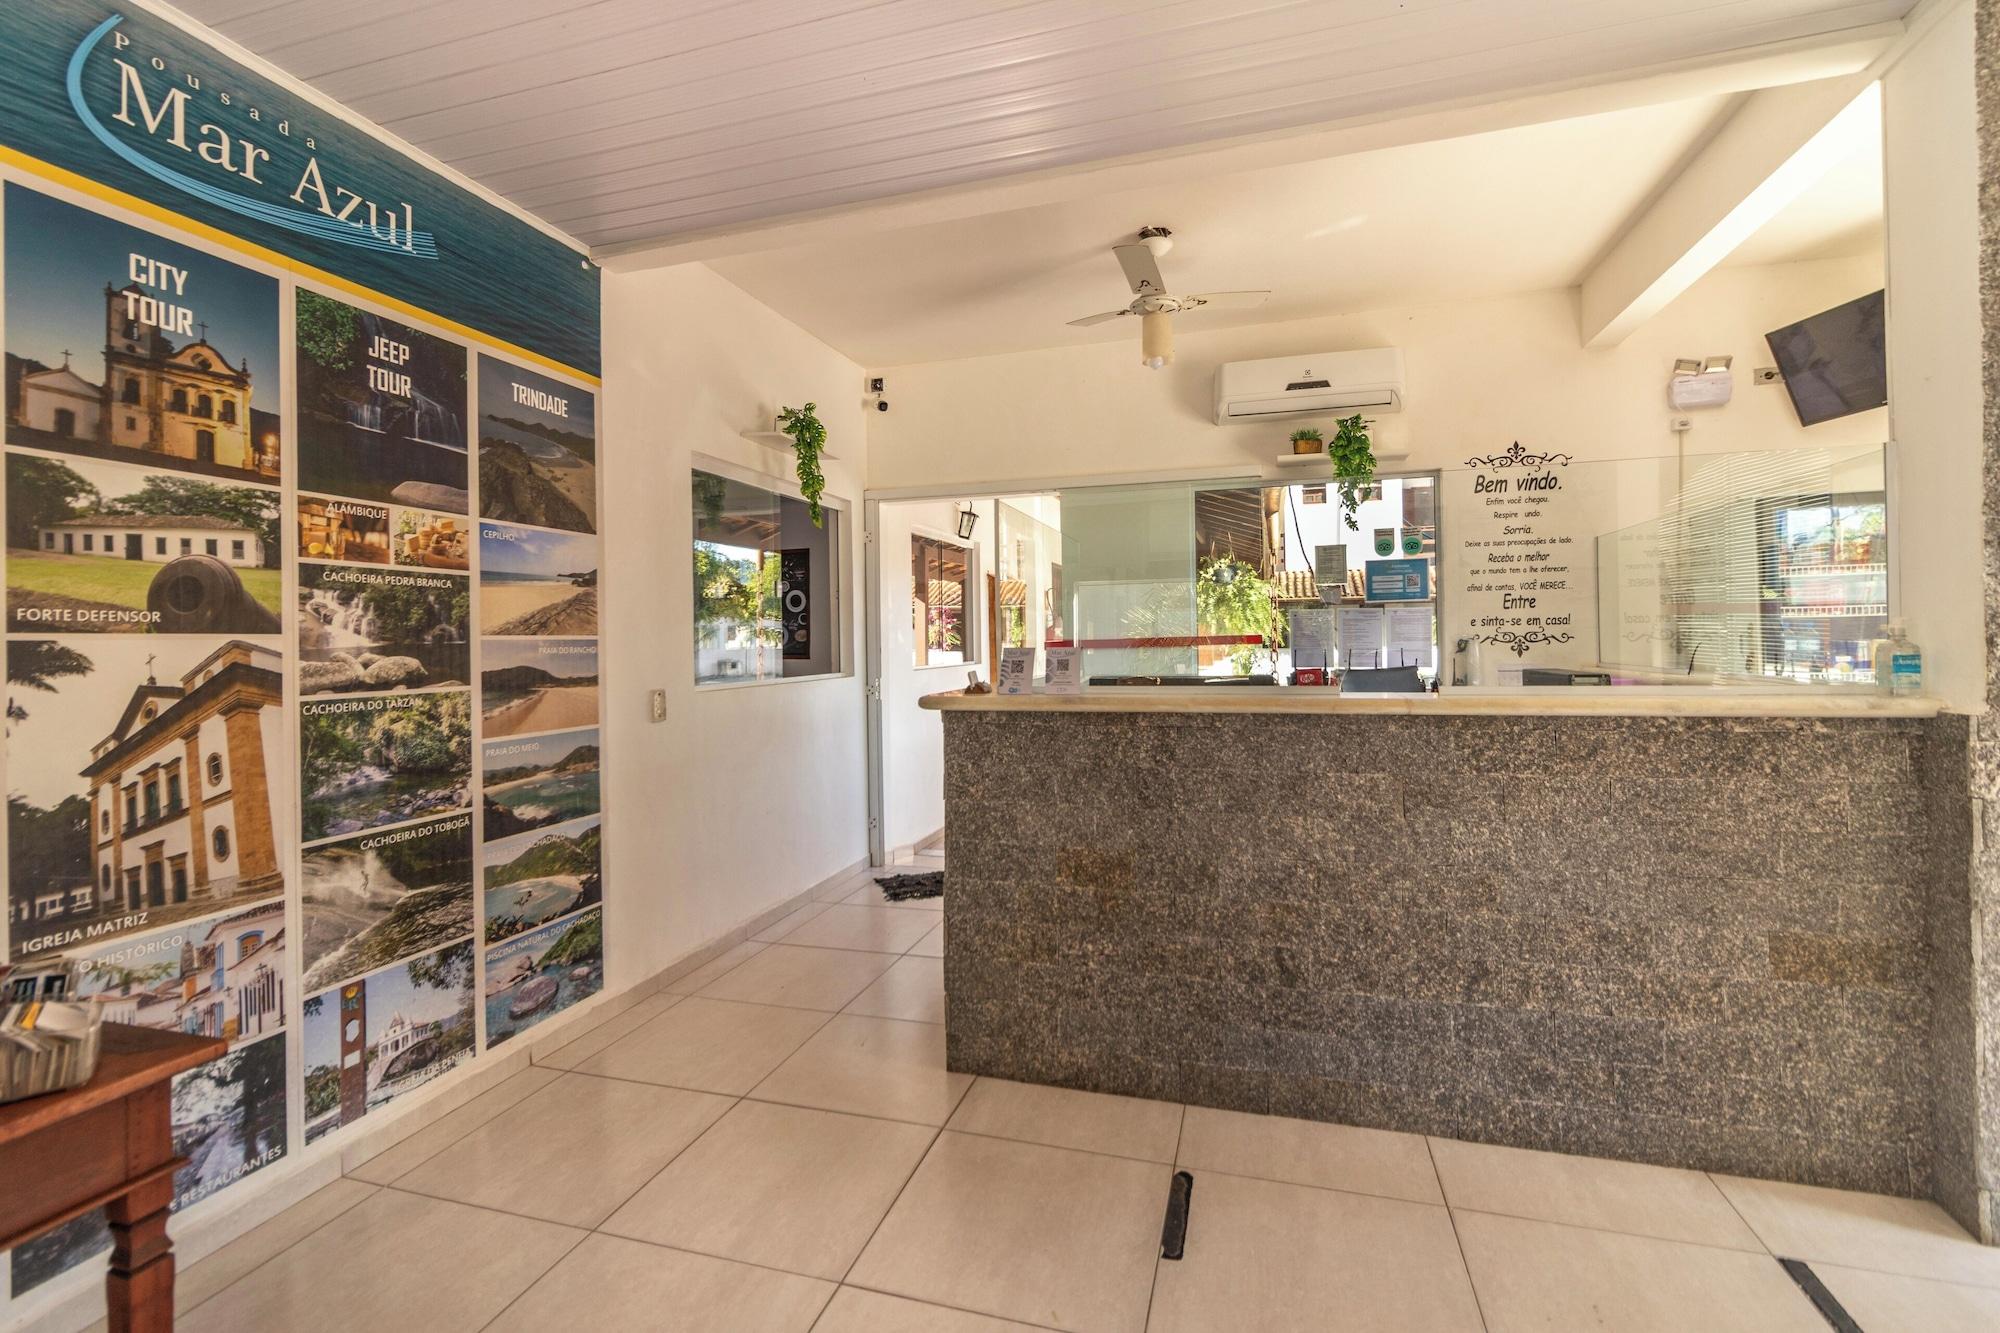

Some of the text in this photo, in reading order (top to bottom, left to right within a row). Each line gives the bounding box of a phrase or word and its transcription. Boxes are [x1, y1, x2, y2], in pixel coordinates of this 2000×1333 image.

[114, 31, 316, 150] Pousada
[112, 58, 417, 254] Mar Azul
[129, 253, 188, 296] CITY
[122, 290, 193, 337] TOUR
[368, 335, 410, 366] JEEP
[366, 364, 411, 399] TOUR
[511, 382, 568, 418] TRINDADE
[1474, 470, 1562, 494] Bem vindo.
[1486, 496, 1550, 506] Enfim você chegou.
[326, 502, 388, 520] ALAMBIQUE
[1494, 511, 1518, 520] Respire
[483, 529, 514, 541] CEPILHO
[1503, 525, 1534, 535] Sorria.
[1465, 540, 1481, 548] Deixe
[1507, 538, 1547, 547] preocupações
[1488, 553, 1515, 563] Receba
[1525, 551, 1550, 562] melhor
[1541, 565, 1570, 573] oferecer,
[323, 571, 453, 589] CACHOEIRA PEDRA BRANCA
[1467, 584, 1483, 592] afinal
[1495, 584, 1517, 592] contas,
[1520, 579, 1538, 590] VOCÊ
[1503, 593, 1536, 609] Entre
[16, 608, 161, 623] FORTE DEFENSOR
[1470, 613, 1571, 627] e sinta-se em casa!
[569, 646, 597, 654] RANCHO
[303, 698, 423, 716] CACHOEIRA DO TARZAN
[486, 742, 539, 757] PRAIA DO MEIO
[360, 816, 471, 851] CACHOEIRA DO TOBOGÃ
[21, 912, 149, 954] IGREJA MATRIZ
[487, 946, 517, 961] PISCINA
[519, 932, 550, 949] NATURAL
[550, 928, 561, 936] DO
[180, 1145, 282, 1205] RESTAURANTES
